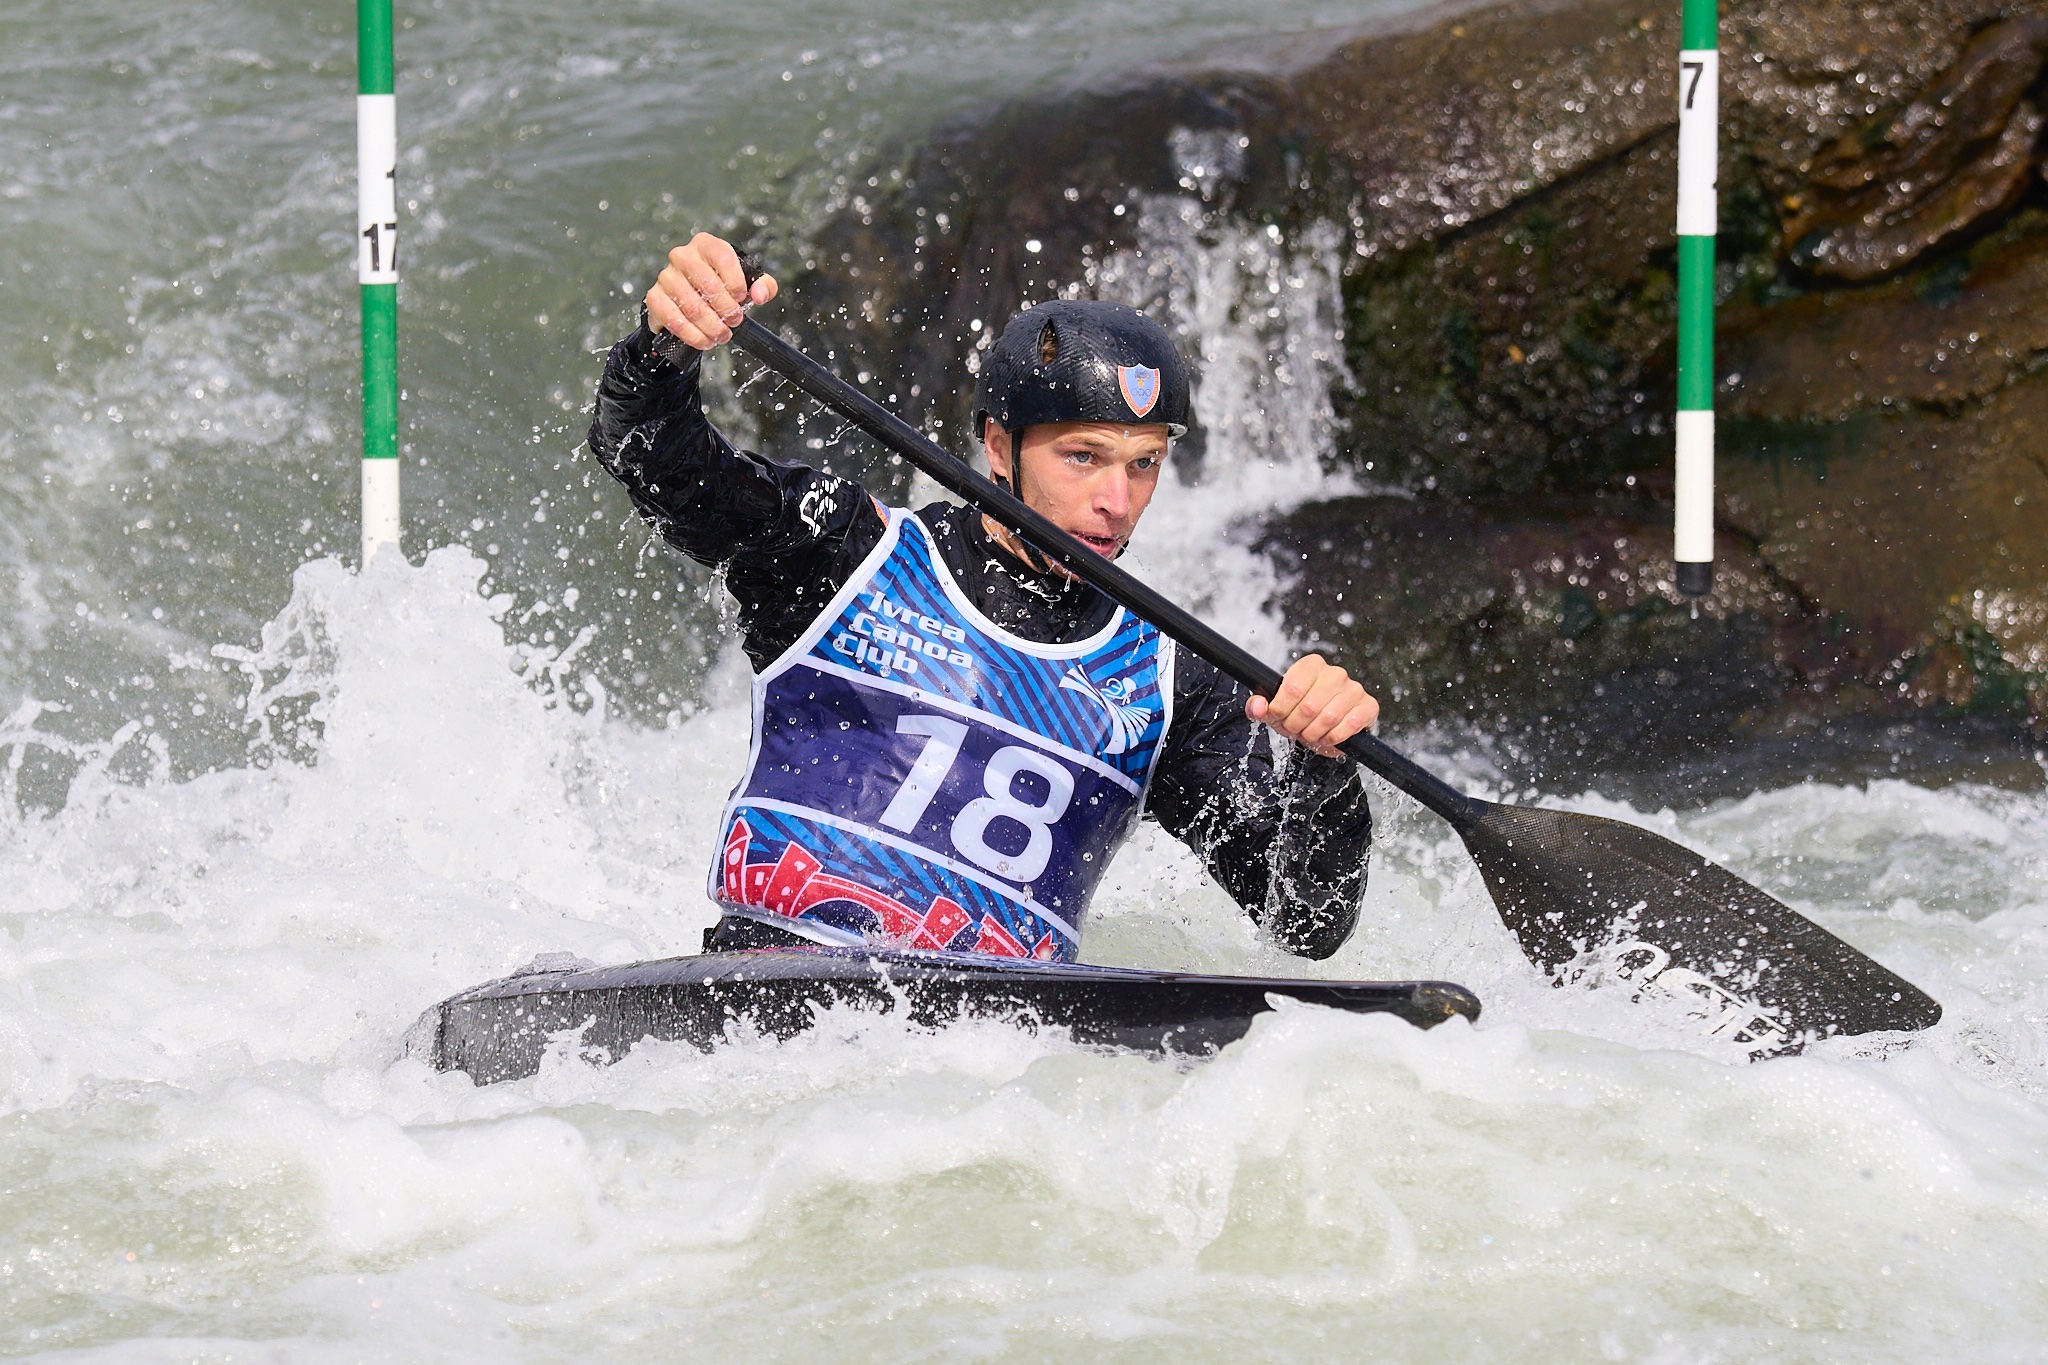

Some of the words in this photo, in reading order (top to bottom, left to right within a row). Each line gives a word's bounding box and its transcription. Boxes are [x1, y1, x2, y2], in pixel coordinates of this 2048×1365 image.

[852, 612, 974, 669] Canoa
[868, 590, 966, 644] Ivrea
[834, 633, 919, 675] Club
[878, 714, 1076, 883] 18
